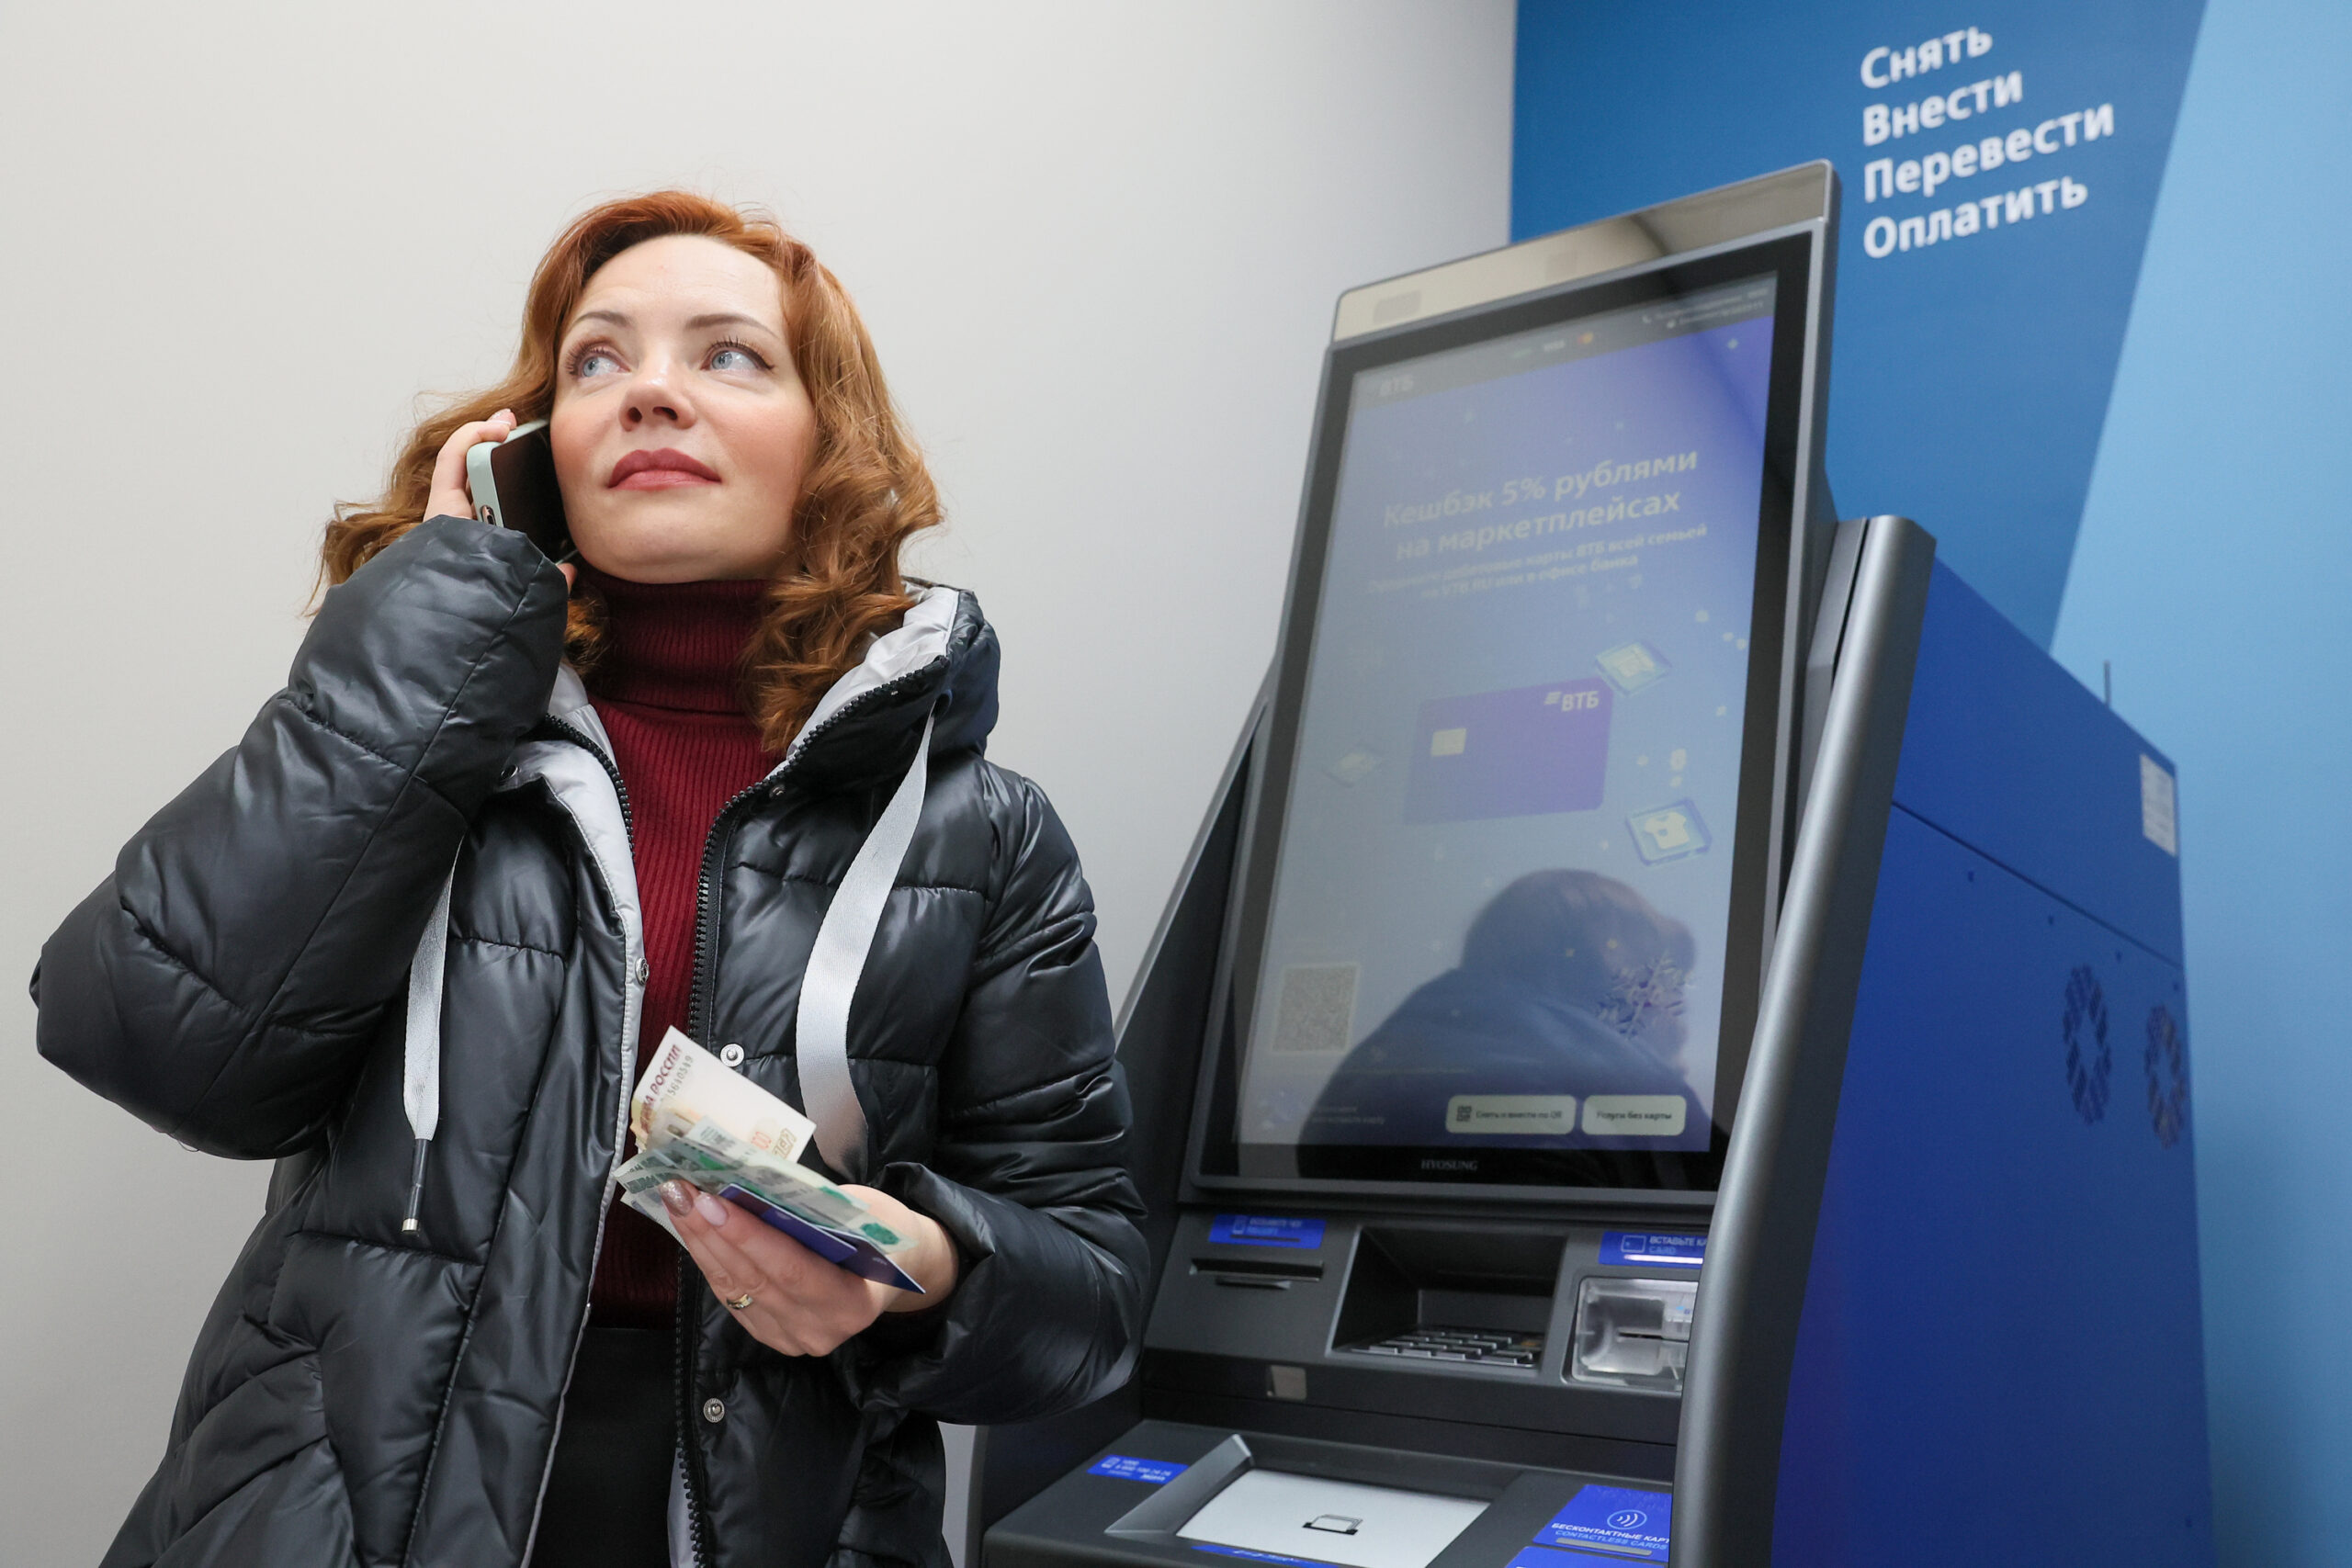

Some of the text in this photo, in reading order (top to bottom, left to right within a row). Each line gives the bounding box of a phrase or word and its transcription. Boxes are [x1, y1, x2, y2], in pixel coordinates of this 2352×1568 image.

[1860, 26, 1993, 89] Снять
[1862, 70, 2023, 147] Внести
[1864, 103, 2114, 203] Перевести
[1863, 175, 2088, 259] Оплатить
[1384, 451, 1698, 527] Кешбэк 5% рублями
[1396, 491, 1681, 561] на маркетплейсах
[1576, 540, 1605, 558] ВТБ
[1562, 691, 1600, 712] ВТБ
[1420, 1158, 1478, 1171] HYOSUNG
[1551, 1522, 1645, 1540] БЕСКОНТАКТНЫЕ
[1555, 1529, 1668, 1551] CONTACTLESS CARDS
